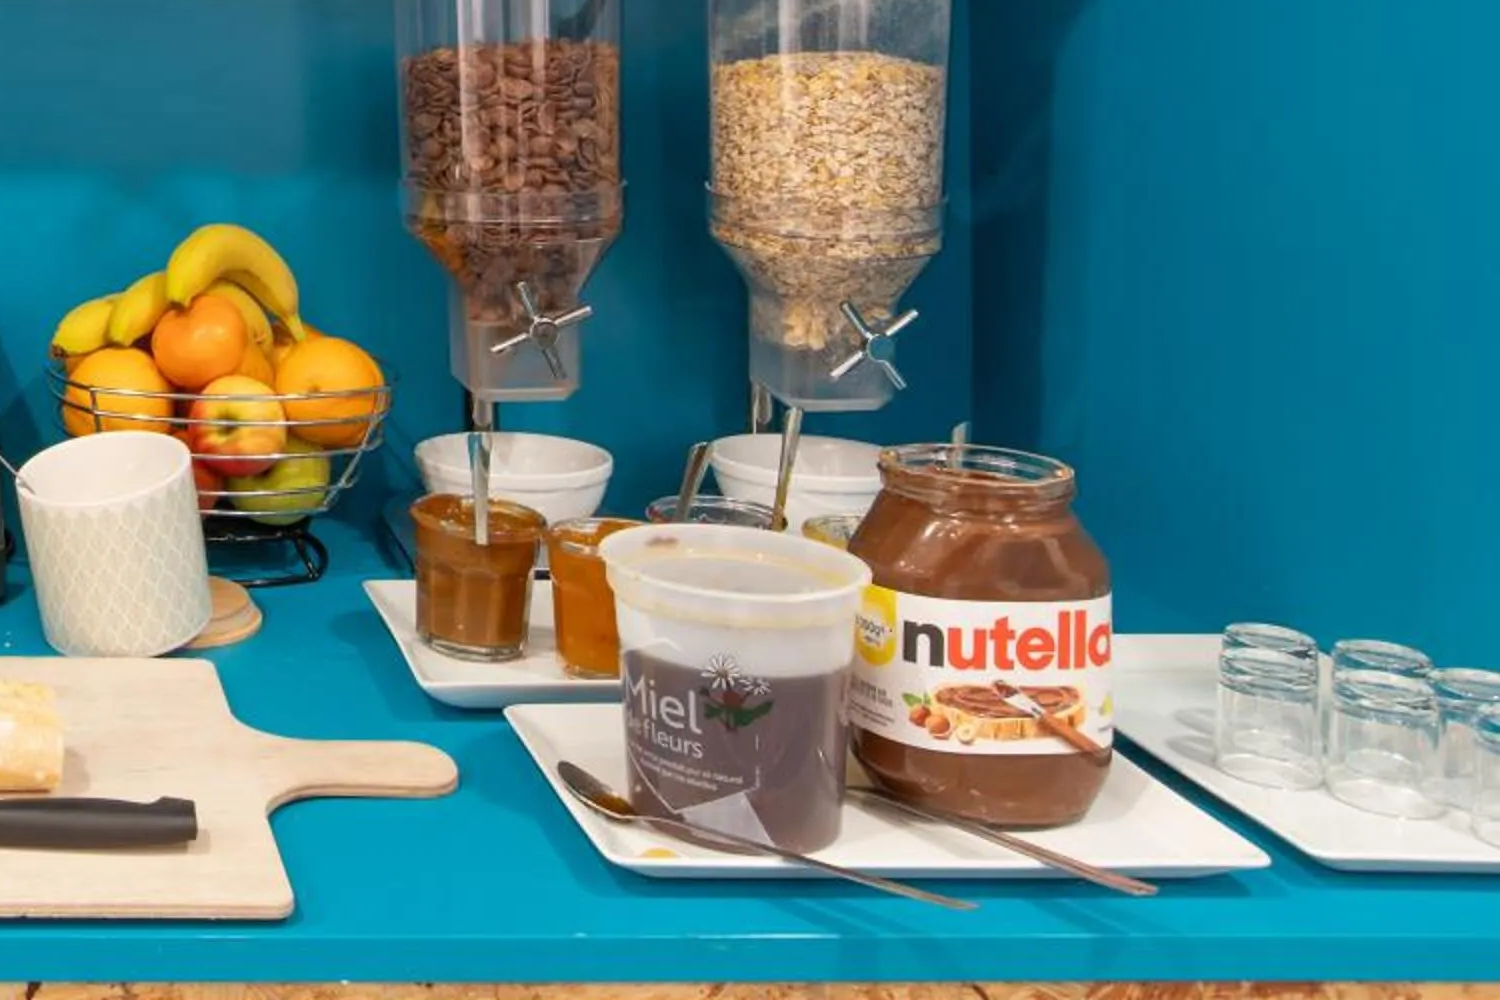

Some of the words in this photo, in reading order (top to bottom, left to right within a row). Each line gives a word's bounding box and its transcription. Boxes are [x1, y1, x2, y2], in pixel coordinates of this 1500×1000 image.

[902, 609, 1113, 671] nutella
[625, 668, 703, 735] Miel
[643, 717, 704, 759] fleurs
